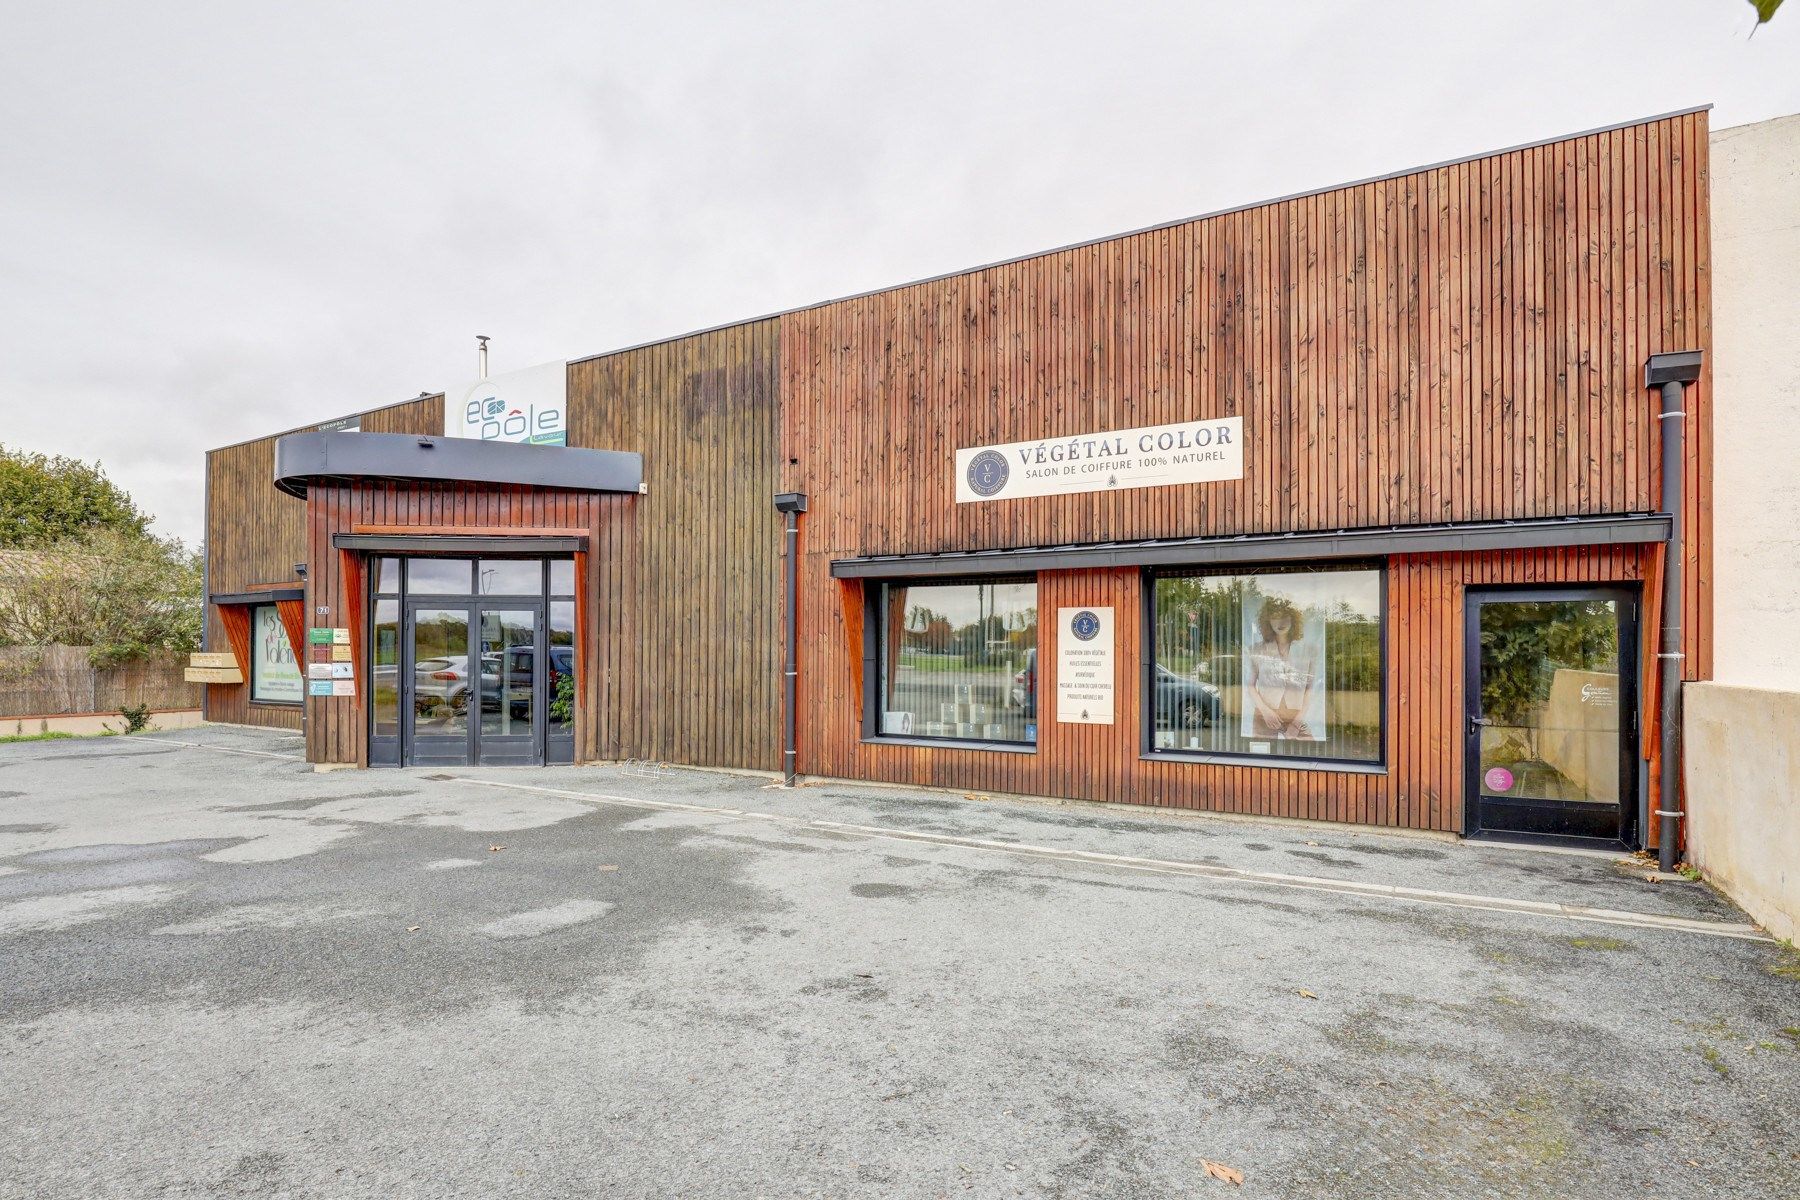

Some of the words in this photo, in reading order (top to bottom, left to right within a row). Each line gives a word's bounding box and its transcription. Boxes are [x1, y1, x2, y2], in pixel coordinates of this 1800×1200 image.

[1019, 438, 1128, 465] VÉGÉTAL
[1139, 426, 1232, 453] COLOR
[984, 463, 991, 472] V
[1026, 467, 1059, 479] SALON
[1063, 465, 1076, 475] DE
[1081, 460, 1132, 474] COIFFURE
[1139, 456, 1168, 468] 100%
[1173, 451, 1226, 464] NATUREL
[983, 474, 991, 483] C
